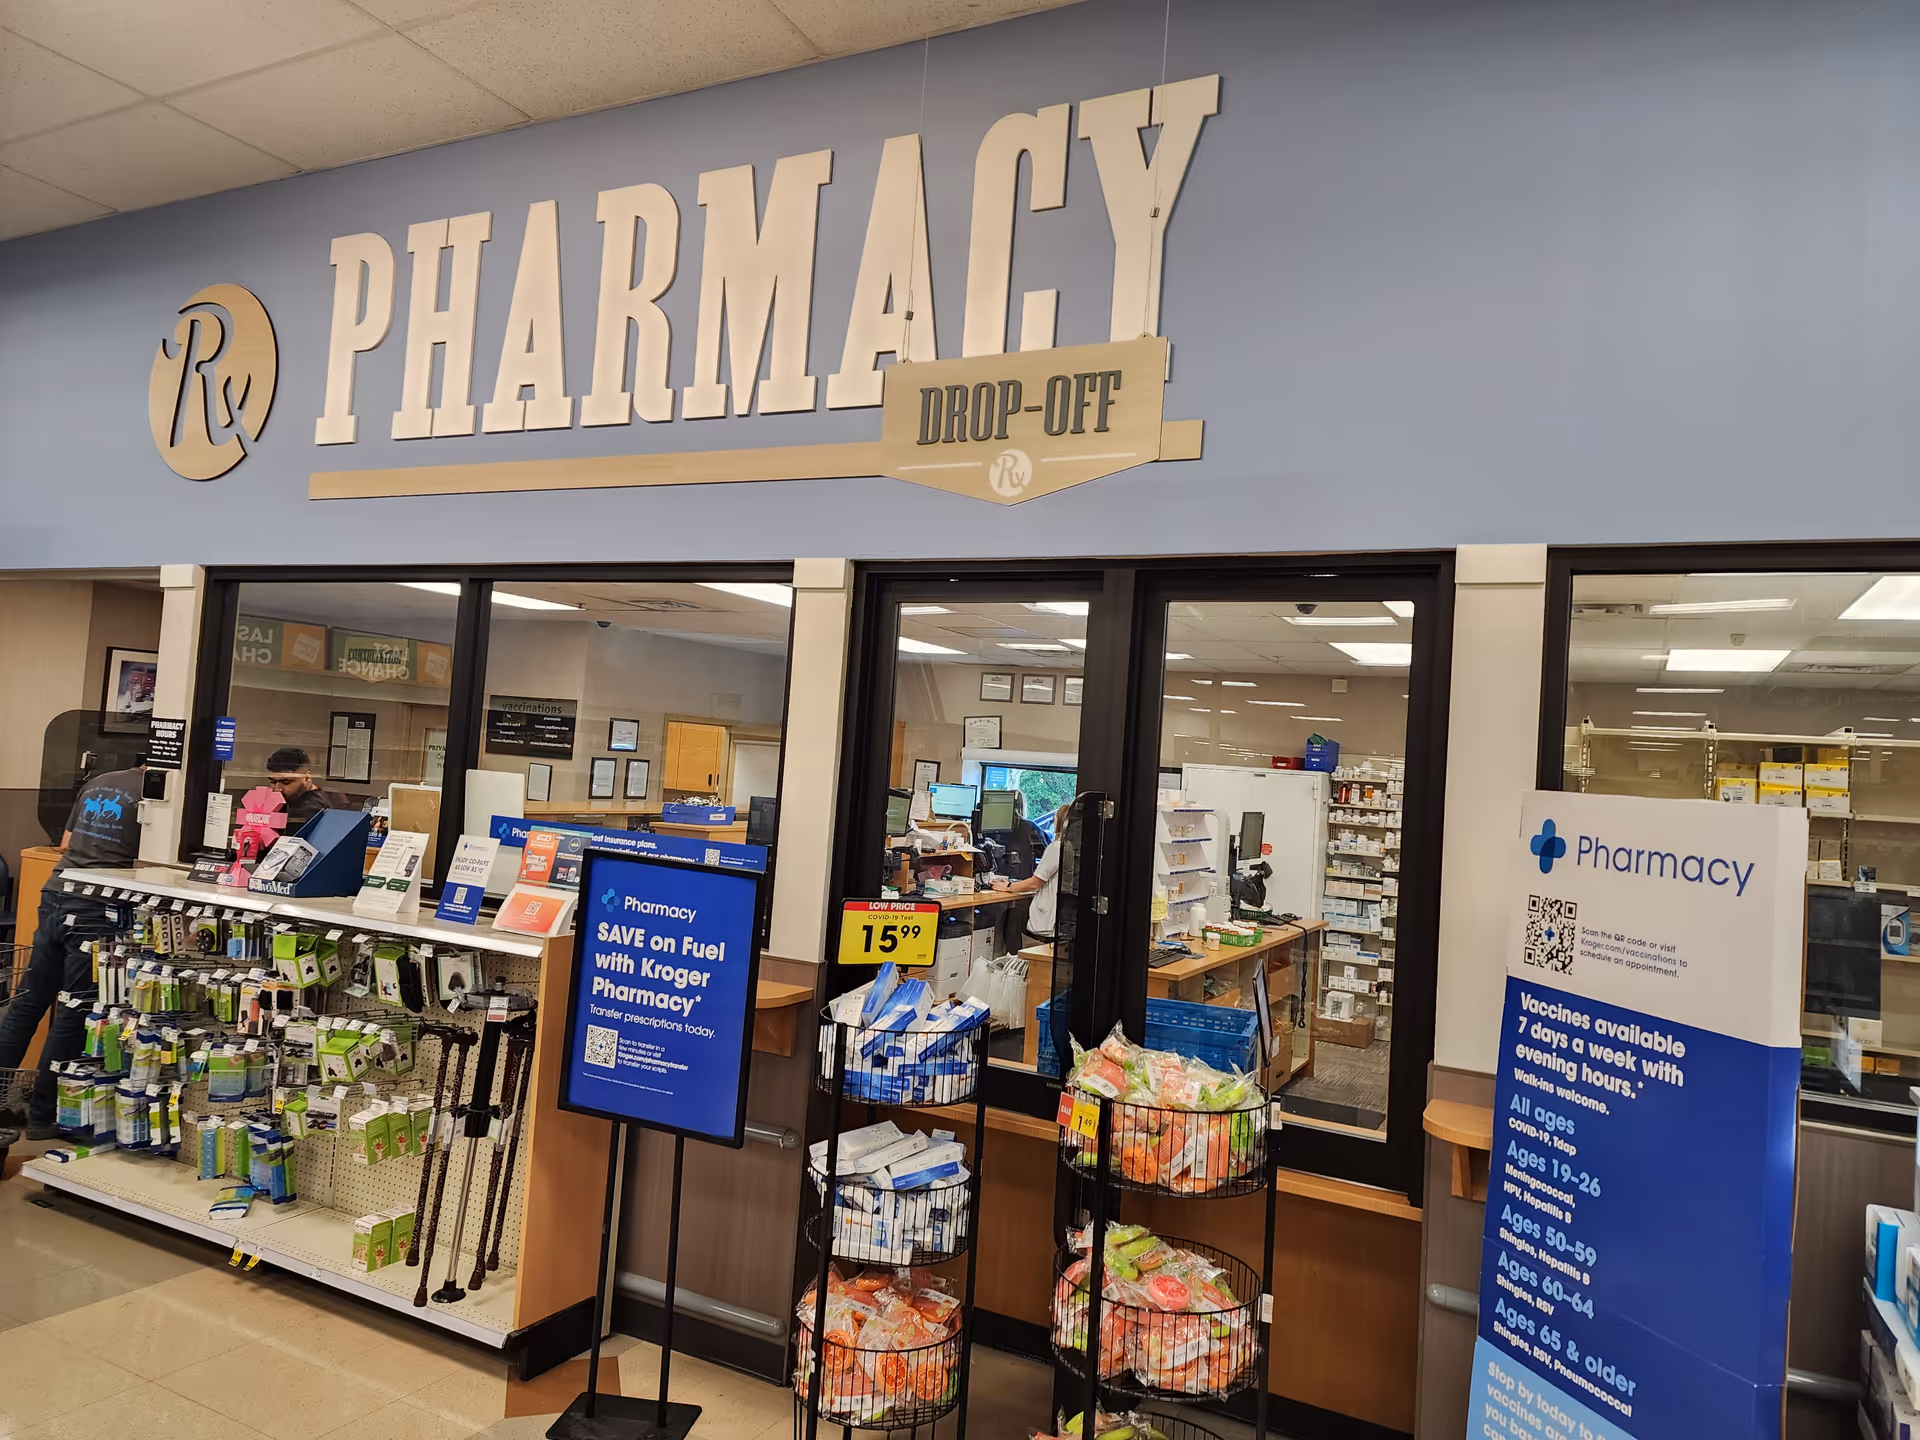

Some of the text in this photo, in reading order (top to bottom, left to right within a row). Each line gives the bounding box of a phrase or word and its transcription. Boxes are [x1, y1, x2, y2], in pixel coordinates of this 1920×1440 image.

[315, 74, 1219, 445] PHARMACY
[917, 370, 1121, 445] DROP-OFF
[151, 721, 184, 731] PHARMACY
[502, 702, 562, 714] vaccinations
[156, 730, 177, 738] HOURS
[1577, 835, 1756, 897] Pharmacy
[624, 896, 697, 923] Pharmacy
[868, 902, 916, 911] LOW PRICE
[597, 922, 726, 962] SAVE on Fuel
[1581, 927, 1599, 938] Scan
[1601, 931, 1612, 940] the
[1614, 934, 1625, 942] QR
[1627, 937, 1647, 948] code
[1660, 942, 1676, 953] visit
[1581, 938, 1688, 968] Kroger.com/vaccinations to
[595, 952, 710, 989] with Kroger
[1580, 949, 1680, 979] schedule an appointment.
[589, 1003, 716, 1039] Transfer prescriptions today.
[1521, 992, 1686, 1058] Vaccines available
[619, 1038, 631, 1046] Scan
[638, 1040, 655, 1050] transfer
[628, 1047, 646, 1056] minutes
[1516, 1043, 1578, 1082] evening
[1518, 1016, 1684, 1087] 7 days a week with
[1514, 1068, 1610, 1115] Walk-ins welcome.
[1510, 1094, 1575, 1135] All ages
[1507, 1140, 1546, 1172] Ages
[1508, 1117, 1576, 1156] COVID-19, Tdap
[1504, 1180, 1572, 1224] HPV, Hepatitis B
[1505, 1162, 1576, 1208] Meningococcal,
[1501, 1204, 1540, 1239] Ages
[1498, 1250, 1538, 1288] Ages
[1500, 1227, 1590, 1285] Shingles, Hepatitis B
[1496, 1274, 1554, 1316] Shingles, RSV
[1495, 1298, 1636, 1397] Ages 65 & older
[1494, 1320, 1632, 1418] Shingles, RSV, Pneumococcal
[1485, 1402, 1507, 1428] you
[1487, 1384, 1542, 1431] vaccines
[1488, 1362, 1514, 1390] Stop
[1518, 1381, 1534, 1404] by
[1537, 1394, 1576, 1433] today
[1580, 1422, 1593, 1440] to
